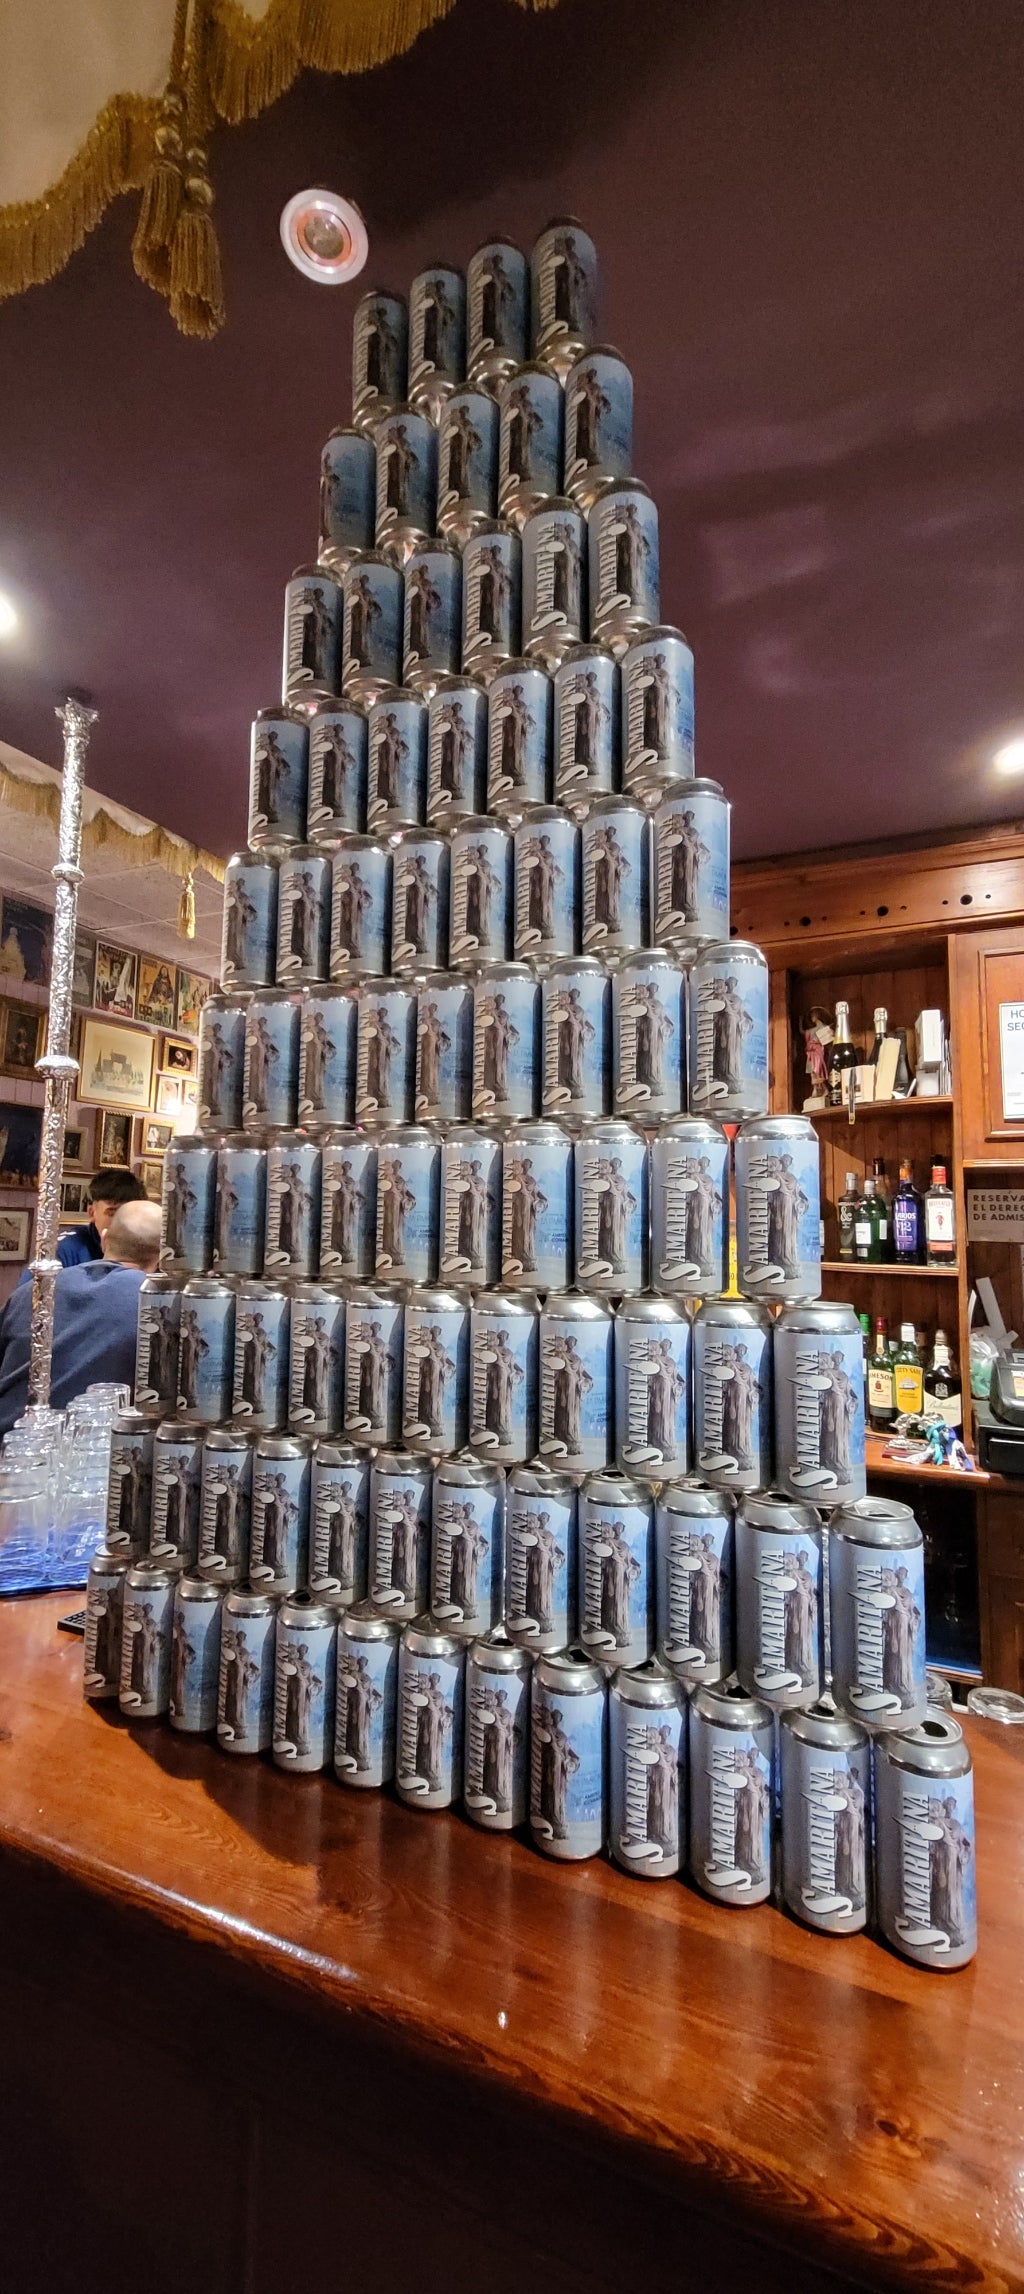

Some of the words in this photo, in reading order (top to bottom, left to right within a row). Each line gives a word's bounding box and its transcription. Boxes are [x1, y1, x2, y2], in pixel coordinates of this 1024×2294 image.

[578, 1156, 614, 1280] SAMARITANA
[660, 1155, 702, 1282] SAMARITANA
[742, 1154, 786, 1285] SAMARITANA
[403, 1324, 432, 1441] SAMARITANA
[470, 1328, 500, 1450] SAMARITANA
[622, 1337, 664, 1467] SAMARITANA
[699, 1341, 740, 1476] SAMARITANA
[786, 1349, 839, 1492] SAMARITANA
[310, 1480, 342, 1595] SAMARITANA
[371, 1488, 406, 1608] SAMARITANA
[432, 1499, 464, 1624] SAMARITANA
[506, 1510, 541, 1638] SAMARITANA
[580, 1518, 617, 1652] SAMARITANA
[663, 1530, 706, 1669] SAMARITANA
[752, 1549, 804, 1695] SAMARITANA
[847, 1564, 902, 1717] SAMARITANA
[619, 1722, 665, 1865] SAMARITANA
[703, 1744, 753, 1892] SAMARITANA
[800, 1766, 854, 1920] SAMARITANA
[892, 1791, 952, 1955] SAMARITANA
